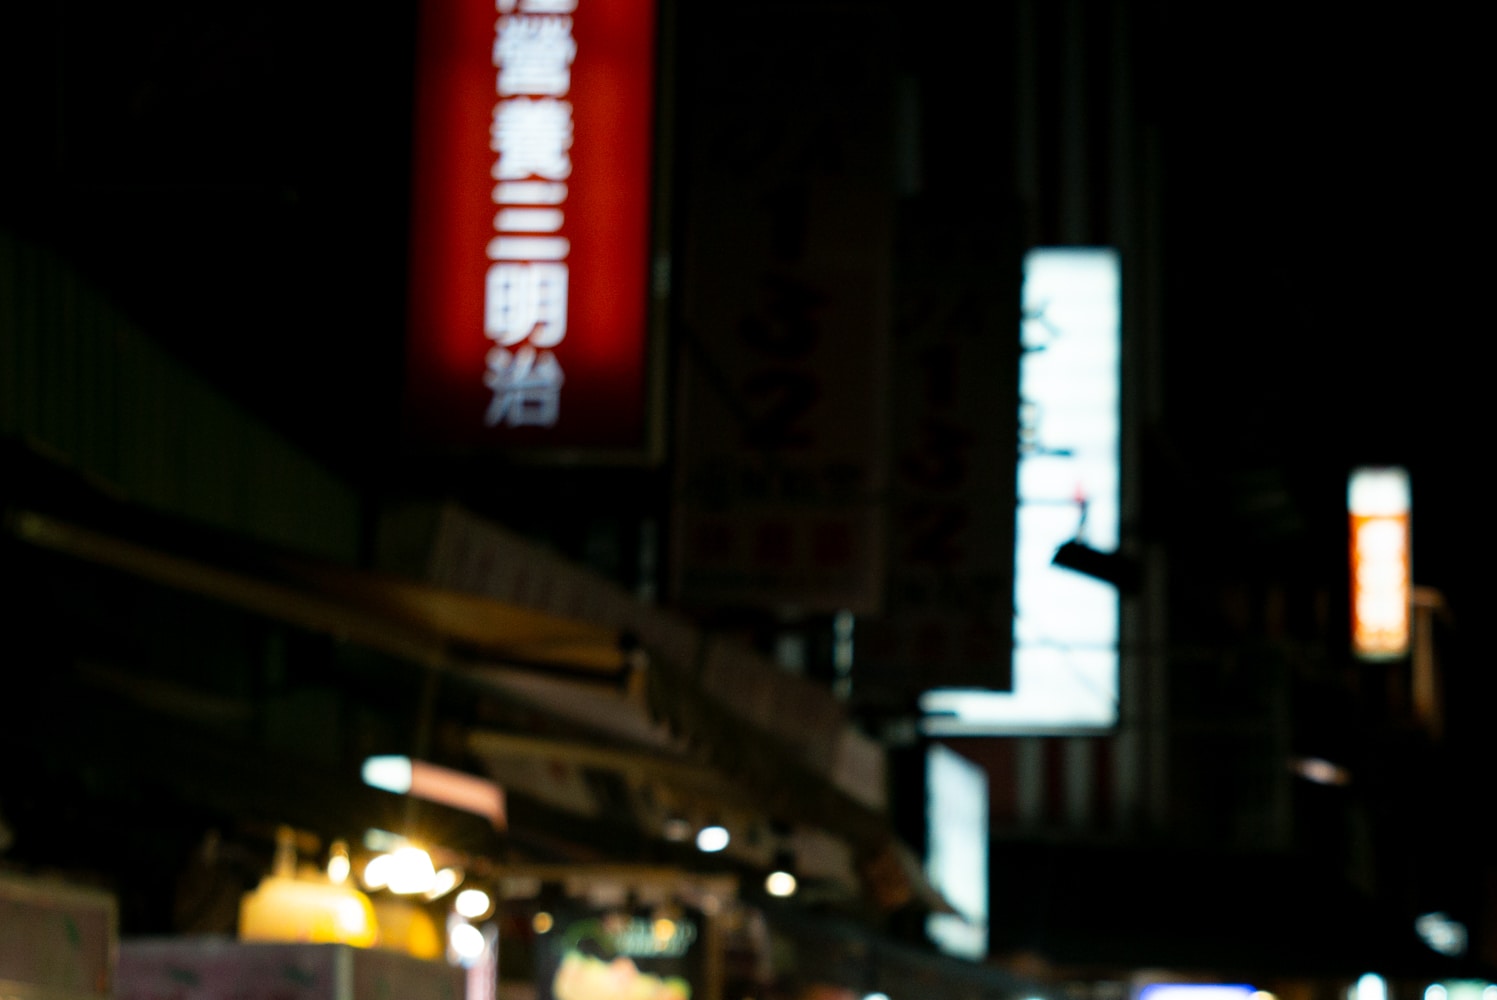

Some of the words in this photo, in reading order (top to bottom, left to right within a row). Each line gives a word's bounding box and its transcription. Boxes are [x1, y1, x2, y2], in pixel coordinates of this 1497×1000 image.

[484, 0, 578, 428] 營養三明治
